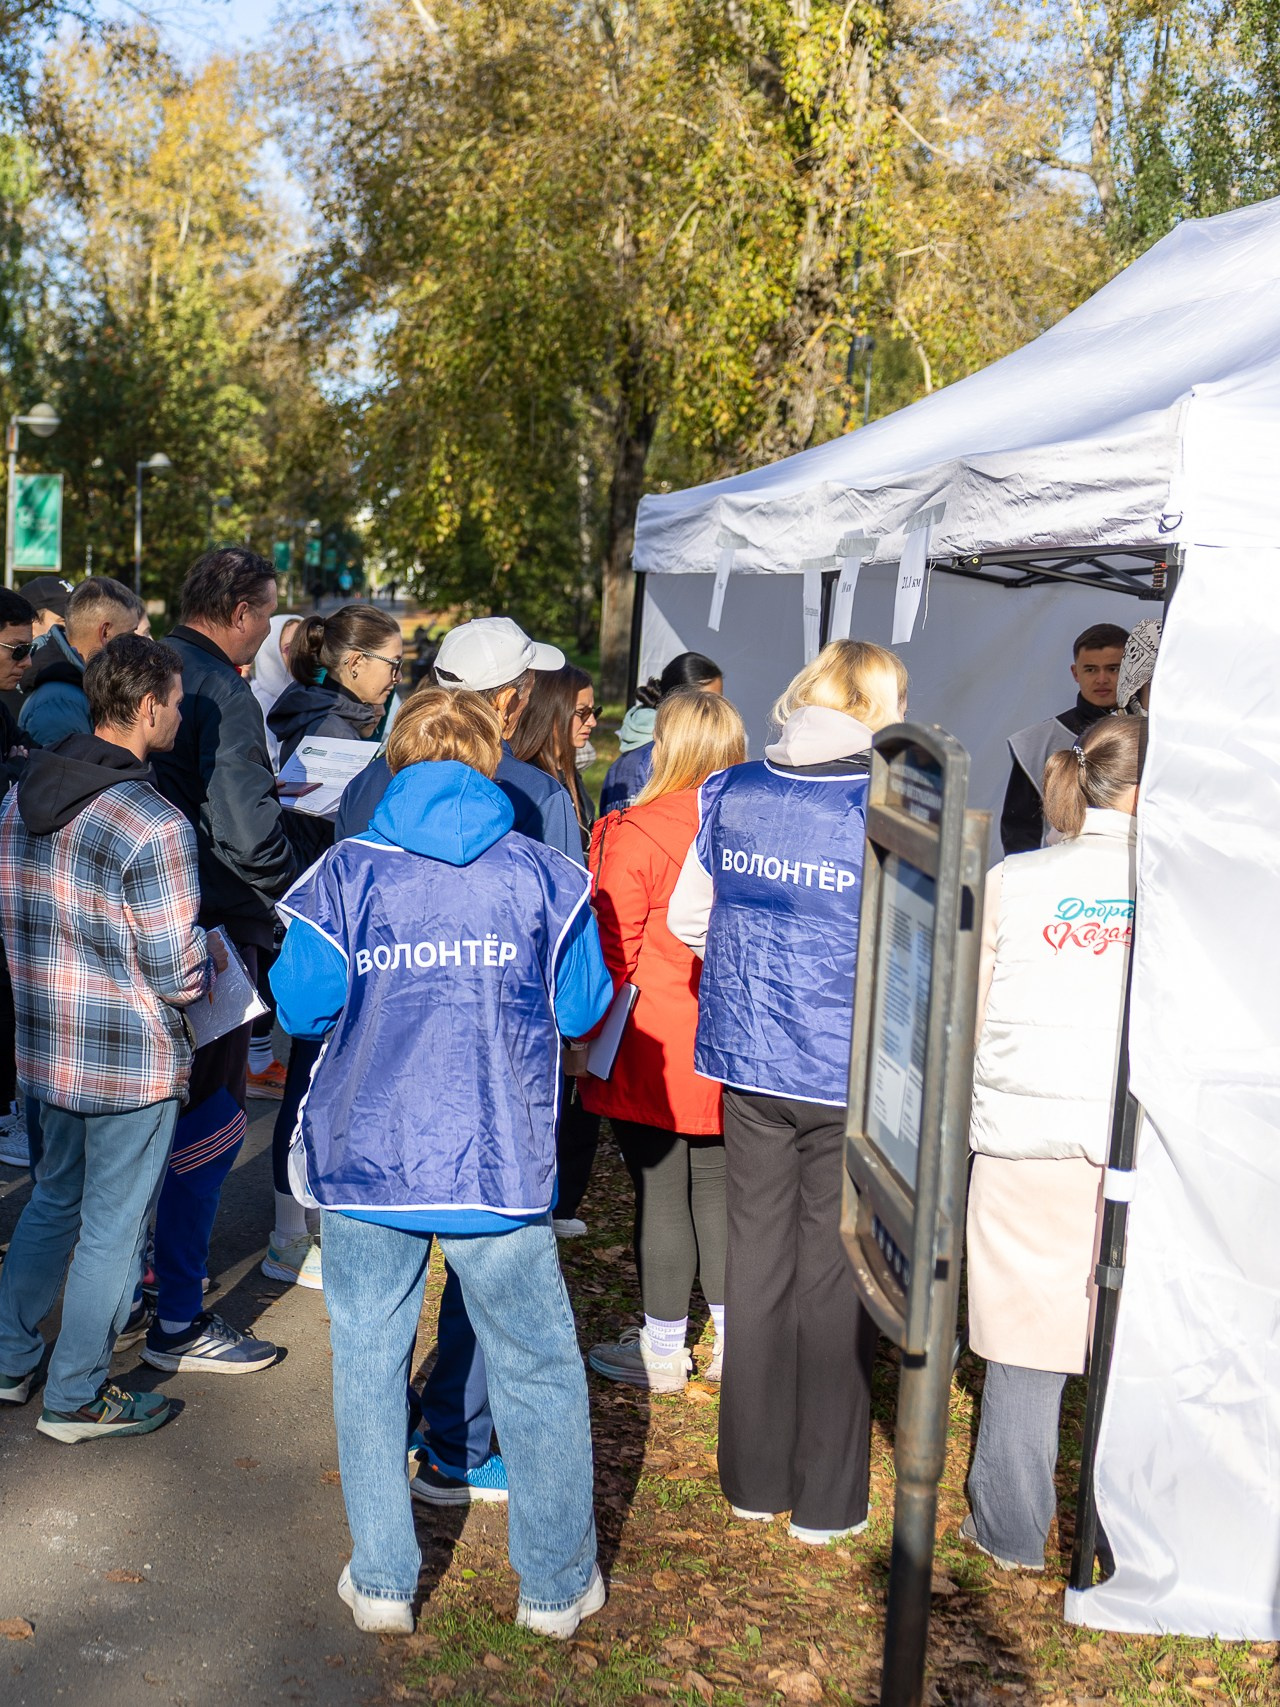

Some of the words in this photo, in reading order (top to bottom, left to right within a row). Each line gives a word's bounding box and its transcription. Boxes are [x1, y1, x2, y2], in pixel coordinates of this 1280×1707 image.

[722, 848, 855, 893] ВОЛОНТЁР
[1054, 897, 1135, 923] Добра
[356, 933, 517, 976] ВОЛОНТЁР
[646, 1360, 674, 1371] HOKA
